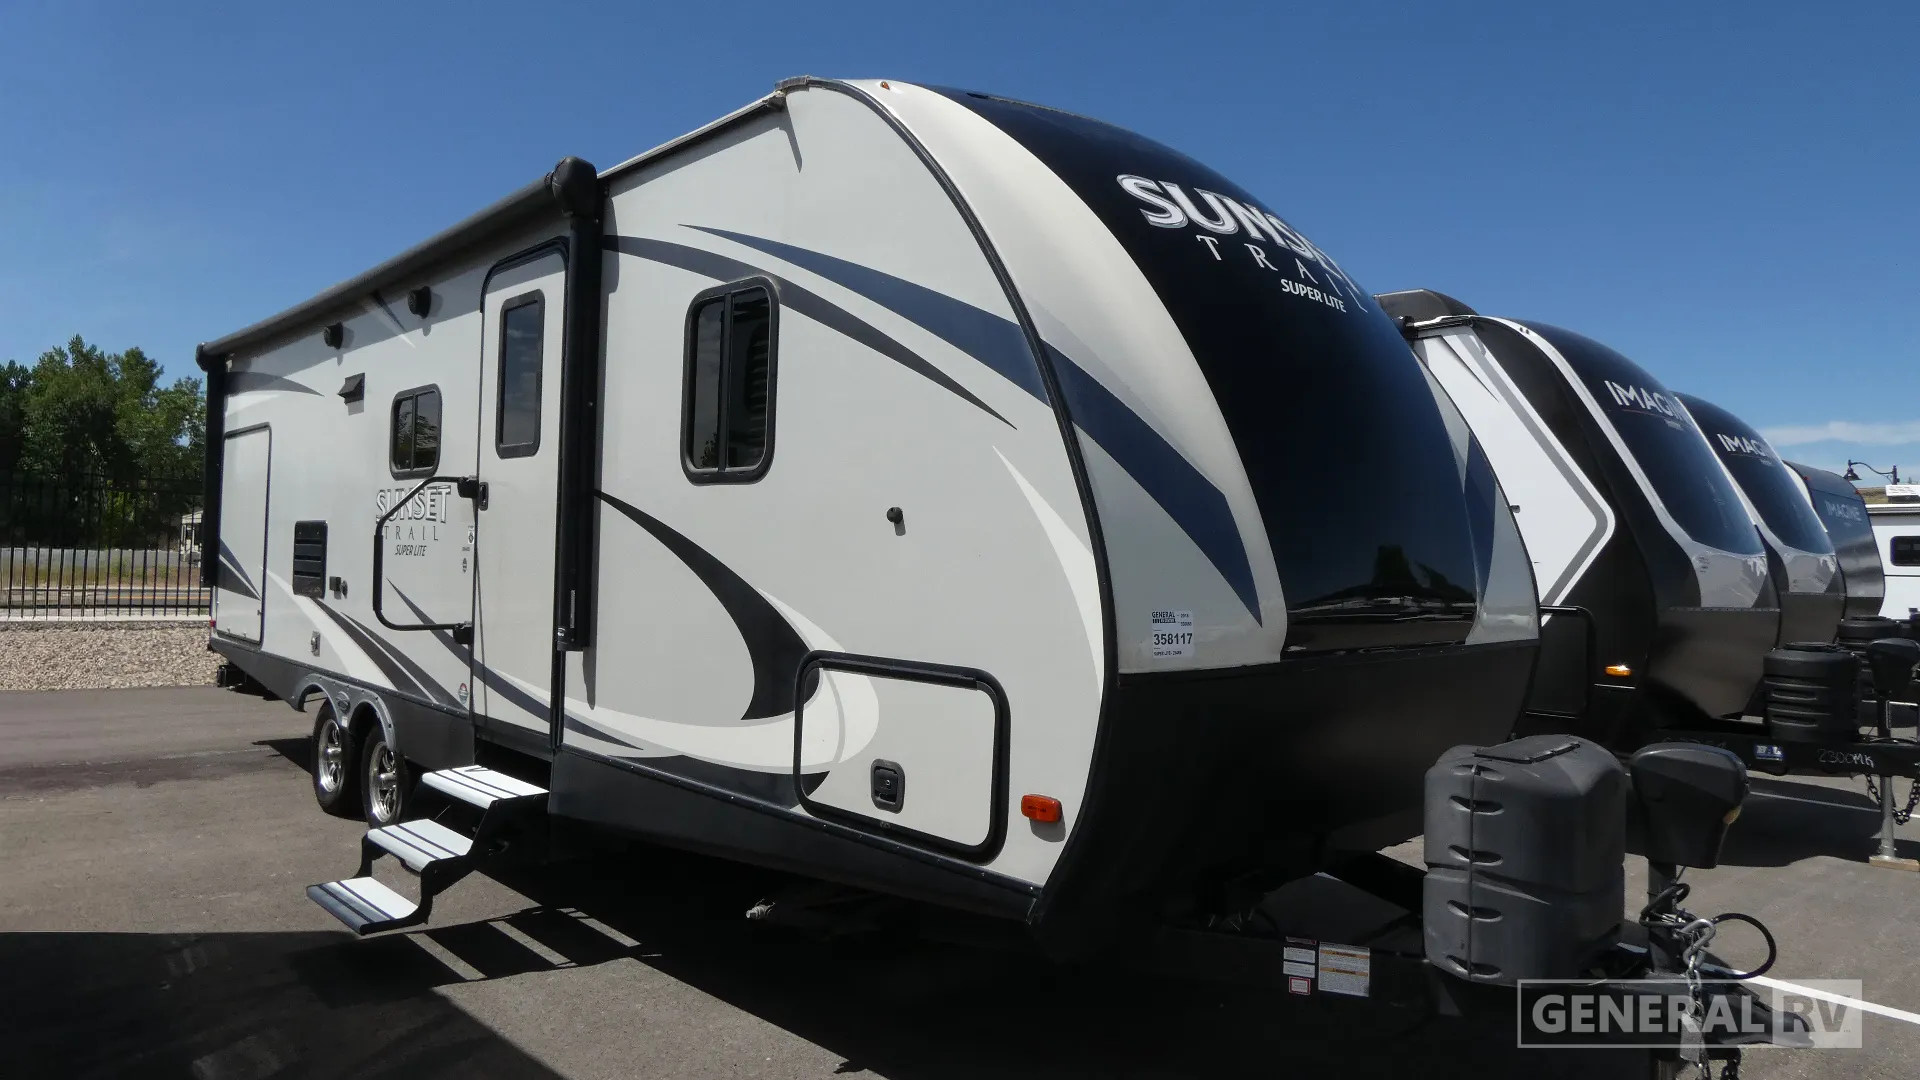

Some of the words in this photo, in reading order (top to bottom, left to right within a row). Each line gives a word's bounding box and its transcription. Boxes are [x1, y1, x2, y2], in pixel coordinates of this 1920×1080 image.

[1196, 234, 1369, 313] TRAIL
[1280, 278, 1323, 303] SUPER
[1323, 293, 1347, 313] LITE
[376, 485, 451, 524] SUNSET
[384, 525, 439, 541] TRAIL
[395, 544, 413, 556] SUPER
[413, 545, 427, 557] LITE
[1153, 633, 1192, 645] 358117
